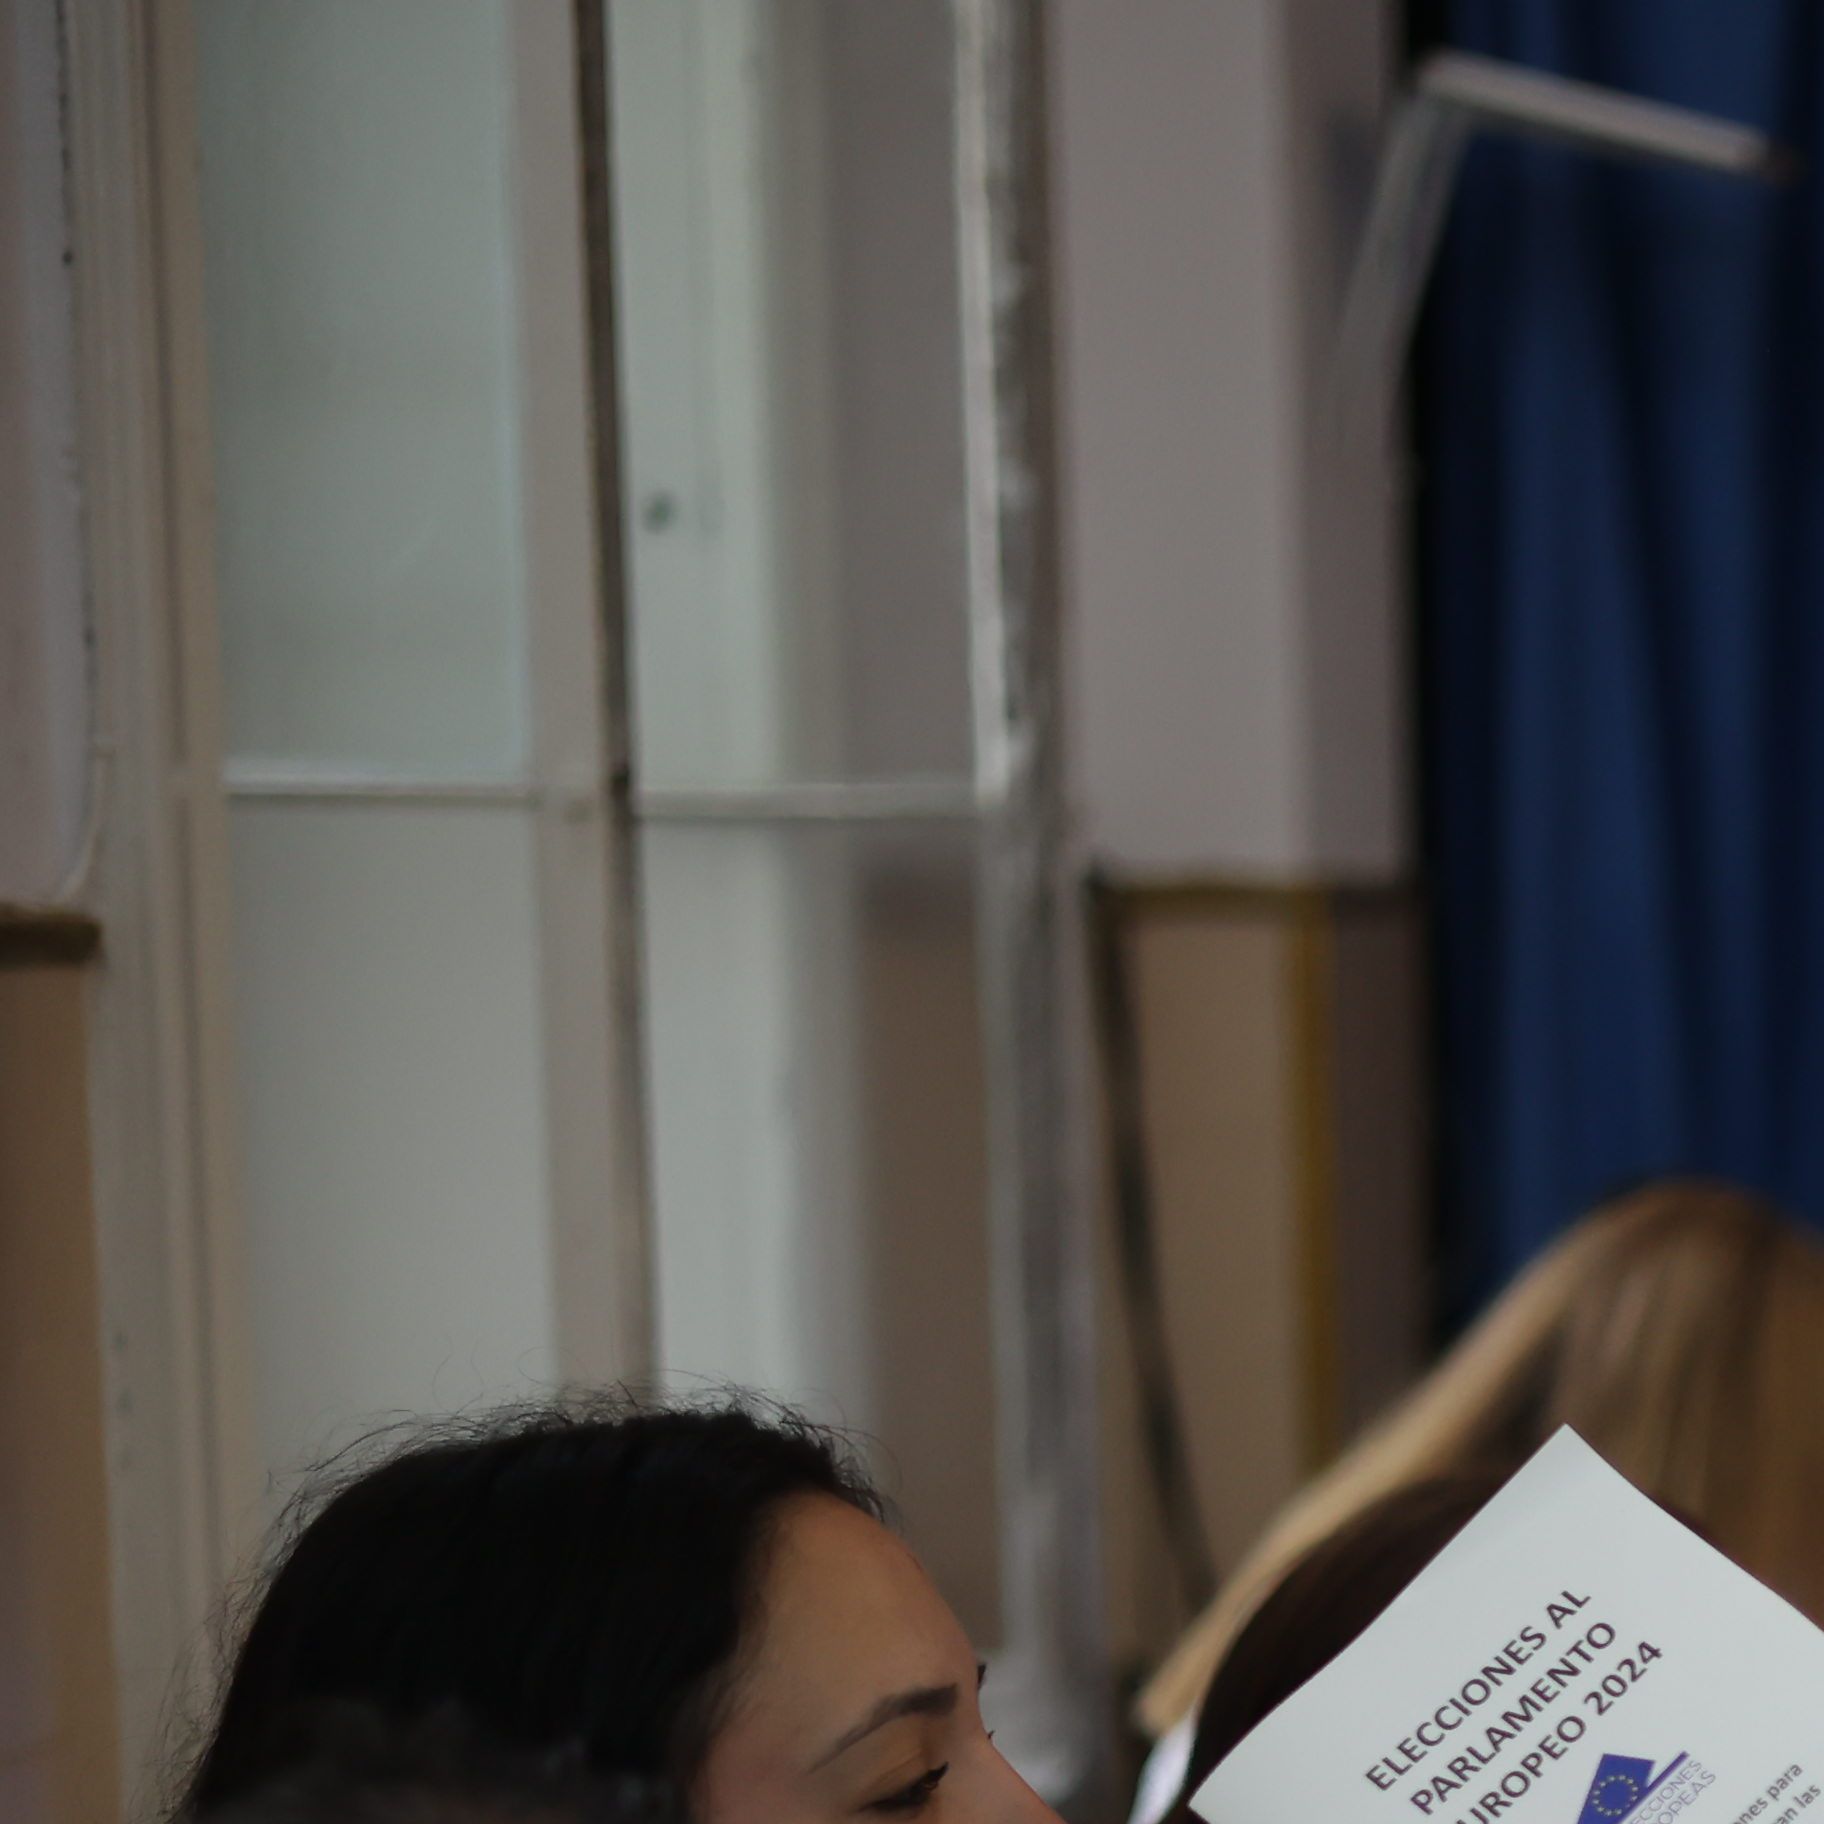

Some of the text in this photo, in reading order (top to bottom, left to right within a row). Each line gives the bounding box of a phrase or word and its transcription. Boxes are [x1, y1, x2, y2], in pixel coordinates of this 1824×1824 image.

[1364, 1590, 1591, 1791] ELECCIONES AL
[1583, 1641, 1663, 1716] 2024
[1410, 1622, 1616, 1815] PARLAMENTO
[1766, 1763, 1803, 1801] para
[1793, 1784, 1822, 1808] las
